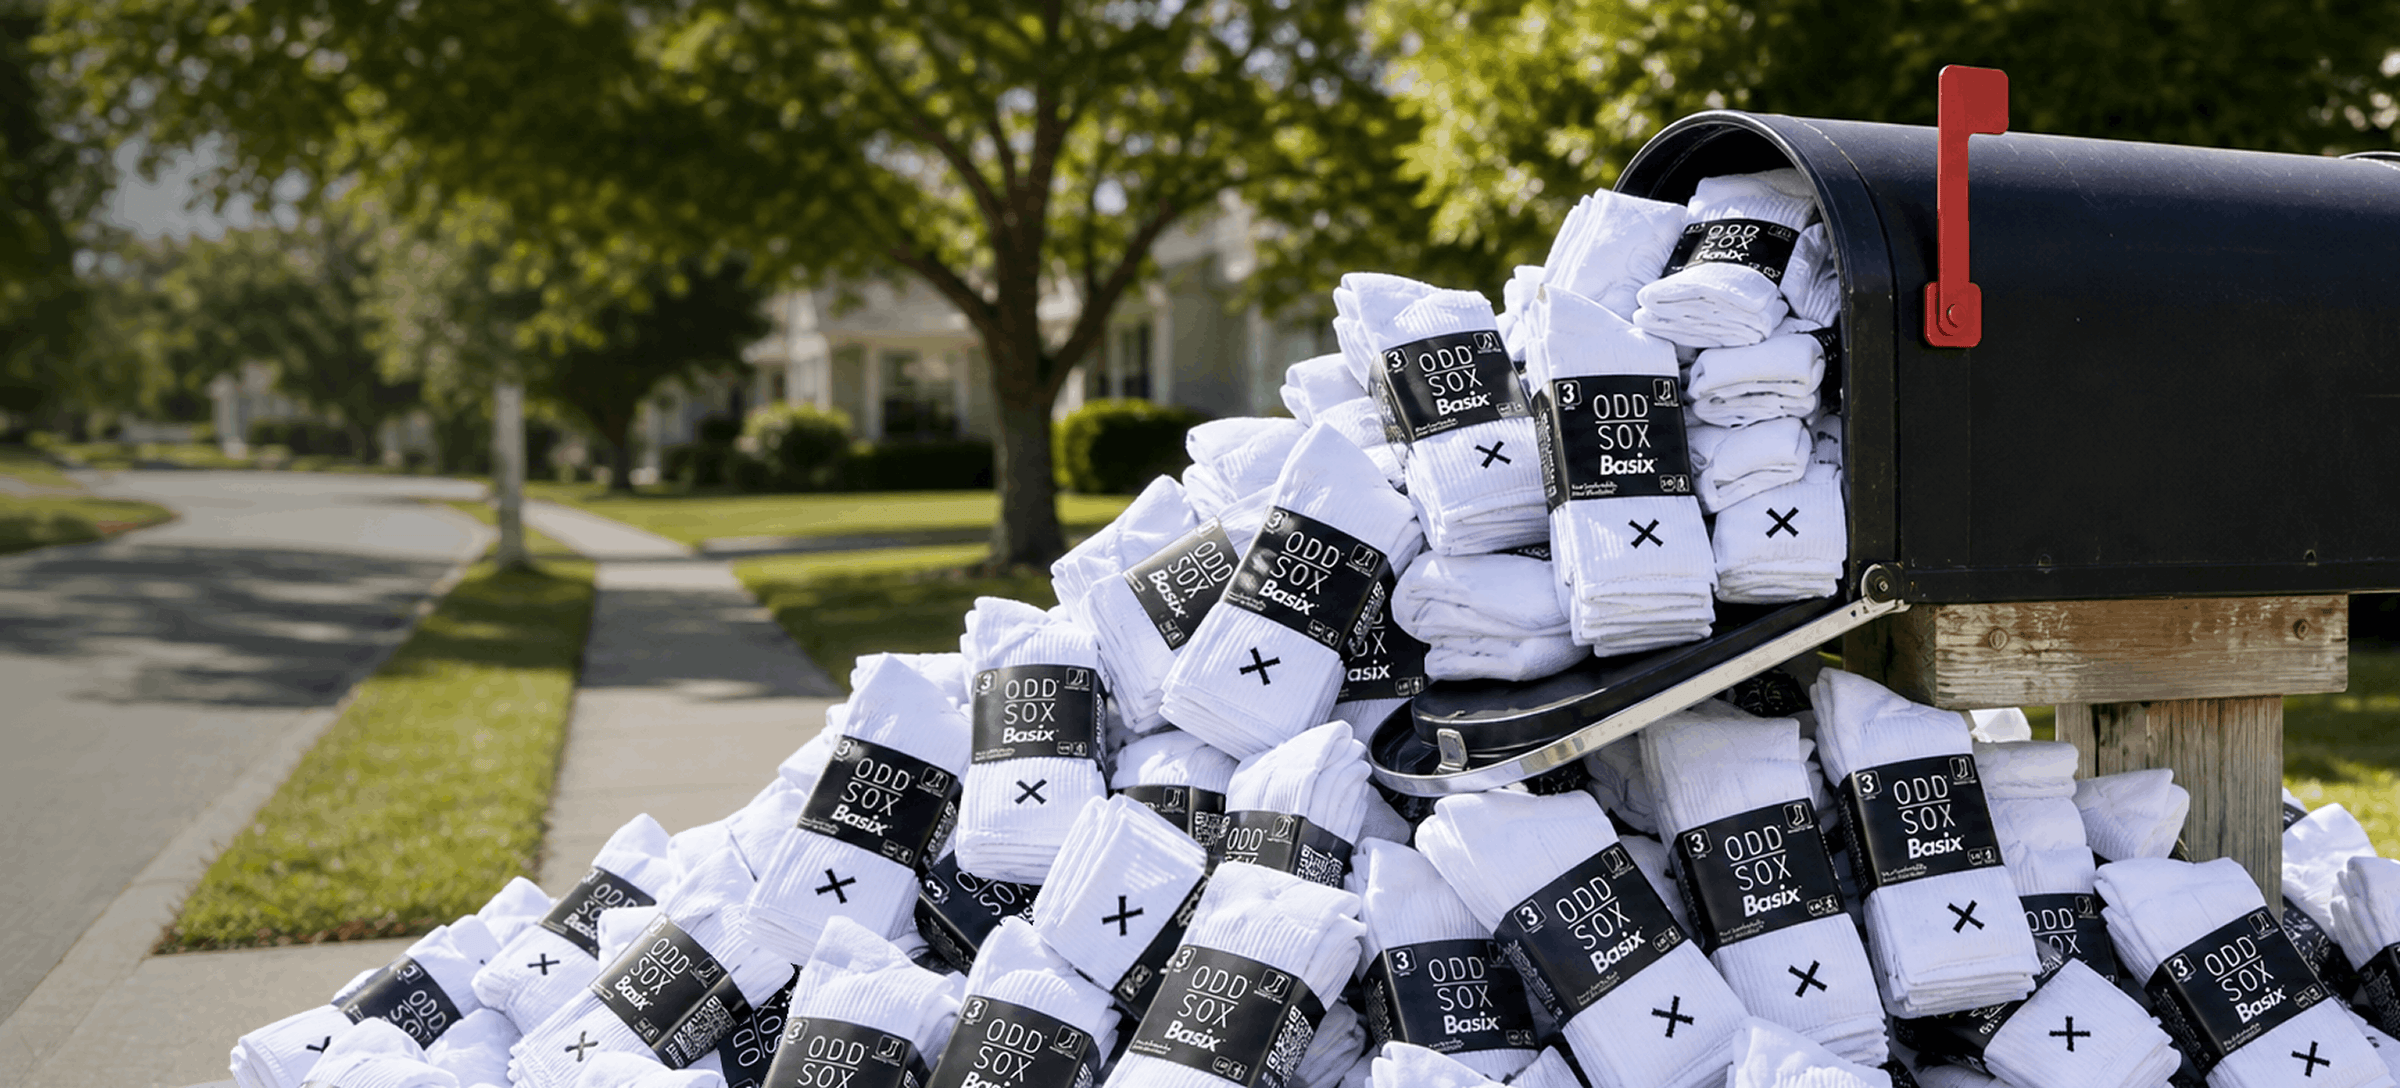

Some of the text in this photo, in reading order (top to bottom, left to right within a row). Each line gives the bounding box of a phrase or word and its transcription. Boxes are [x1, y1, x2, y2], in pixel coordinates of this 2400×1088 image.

[1388, 351, 1402, 368] 3
[1418, 345, 1473, 373] ODD
[1428, 368, 1483, 397] SOX
[1562, 383, 1575, 404] 3
[1436, 391, 1490, 416] Basix
[1593, 393, 1648, 420] ODD
[1598, 424, 1651, 450] SOX
[1600, 452, 1656, 476] Basix
[1267, 511, 1283, 529] 3
[1194, 541, 1234, 583] ODD
[1285, 531, 1340, 569] ODD
[1167, 556, 1210, 599] SOX
[1269, 556, 1329, 595] SOX
[1147, 569, 1187, 618] Basix
[1258, 579, 1316, 616] Basix
[980, 672, 992, 691] 3
[1347, 659, 1391, 682] asix
[1005, 678, 1057, 700] ODD
[1003, 702, 1055, 725] SOX
[836, 740, 850, 756] 3
[1002, 724, 1055, 744] Basix
[855, 757, 910, 791] ODD
[1861, 774, 1875, 793] 3
[841, 781, 900, 816] SOX
[1894, 775, 1948, 805] ODD
[830, 804, 889, 836] Basix
[1901, 804, 1956, 835] SOX
[1690, 832, 1704, 853] 3
[1724, 825, 1782, 861] ODD
[1907, 832, 1963, 859] Basix
[1735, 854, 1792, 891] SOX
[927, 880, 942, 898] 3
[1556, 876, 1612, 923] ODD
[1743, 883, 1801, 918] Basix
[1521, 906, 1538, 926] 3
[1574, 901, 1631, 950] SOX
[650, 938, 691, 975] ODD
[1176, 949, 1191, 968] 3
[1396, 951, 1409, 970] 3
[1590, 930, 1645, 974] Basix
[2204, 936, 2257, 977] ODD
[630, 956, 672, 995] SOX
[1192, 965, 1248, 999] ODD
[1428, 957, 1485, 982] ODD
[2173, 958, 2188, 977] 3
[2221, 959, 2274, 1002] SOX
[409, 990, 447, 1031] ODD
[967, 1000, 983, 1019] 3
[1177, 993, 1235, 1028] SOX
[1437, 984, 1493, 1011] SOX
[2235, 986, 2287, 1024] Basix
[787, 1022, 803, 1040] 3
[986, 1018, 1043, 1054] ODD
[1164, 1019, 1220, 1052] Basix
[1443, 1011, 1500, 1035] Basix
[808, 1035, 865, 1065] ODD
[974, 1046, 1033, 1083] SOX
[797, 1063, 855, 1088] SOX
